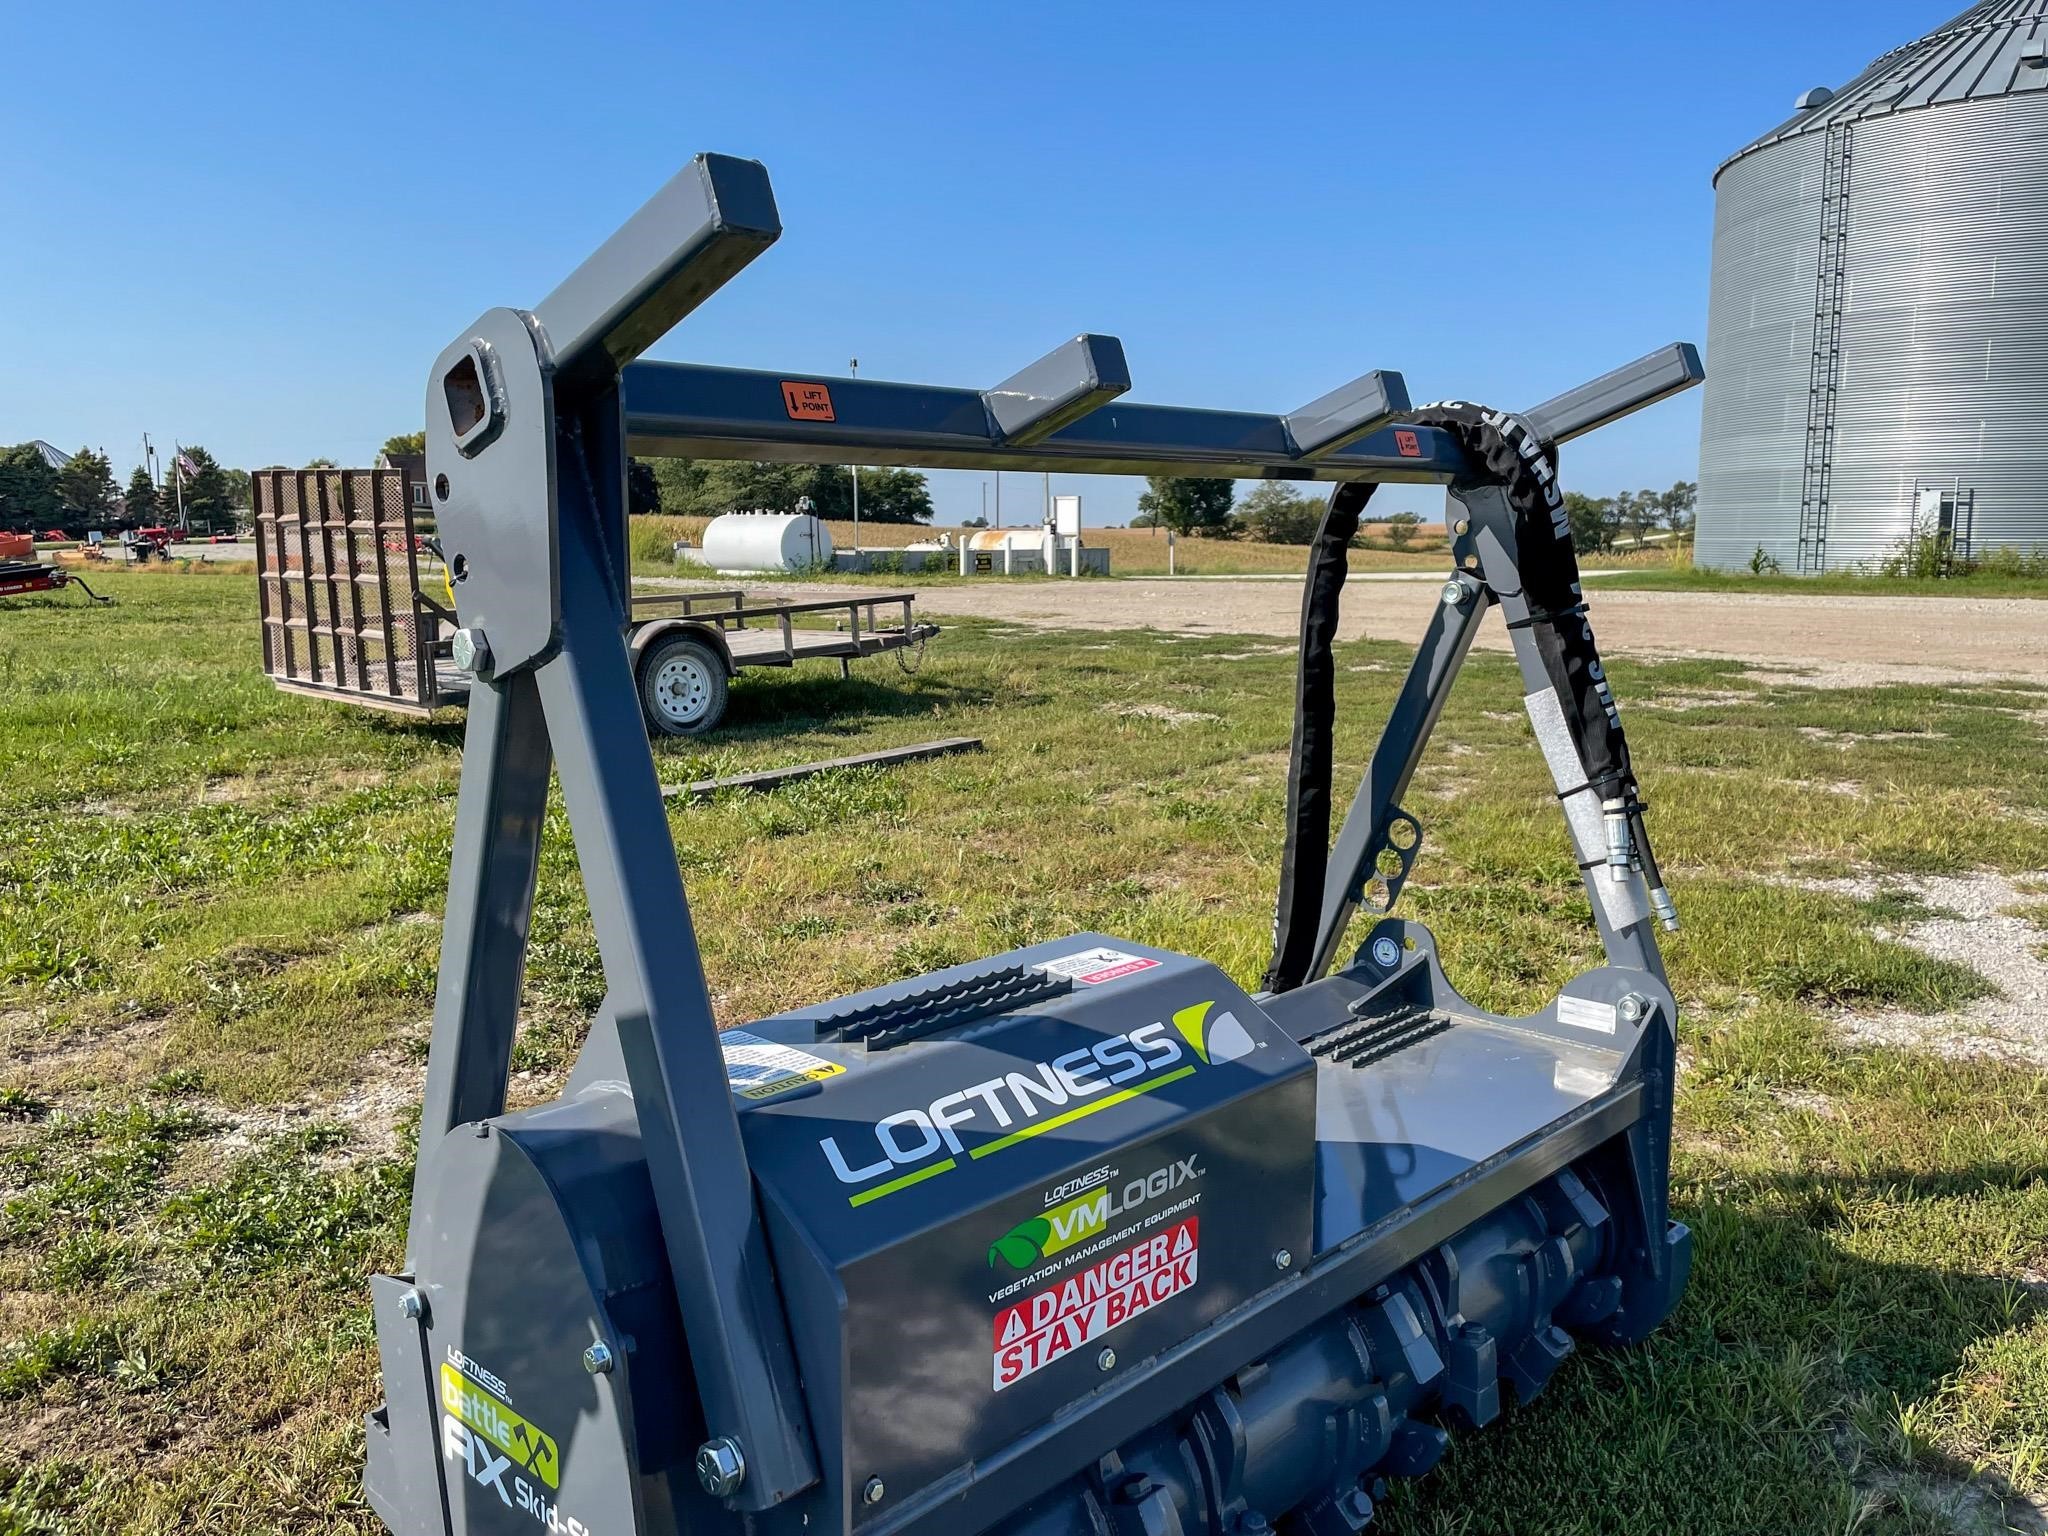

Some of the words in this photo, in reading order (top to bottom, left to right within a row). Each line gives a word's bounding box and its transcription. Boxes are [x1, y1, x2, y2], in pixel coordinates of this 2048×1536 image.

[802, 402, 828, 412] POINT
[803, 391, 822, 400] LIFT
[1088, 964, 1138, 982] DANGER
[751, 1073, 819, 1097] CAUTION
[819, 1021, 1183, 1184] LOFTNESS
[1044, 1164, 1110, 1203] LOFTNESS
[988, 1261, 1062, 1303] VEGETATION
[1065, 1222, 1142, 1266] MANAGEMENT
[1144, 1193, 1201, 1227] EQUIPMENT
[1032, 1234, 1169, 1331] DANGER
[1000, 1305, 1096, 1383] STAY
[1106, 1256, 1192, 1328] BACK
[447, 1344, 507, 1394] LOFTNESS
[444, 1372, 511, 1448] battle
[443, 1414, 513, 1508] AX
